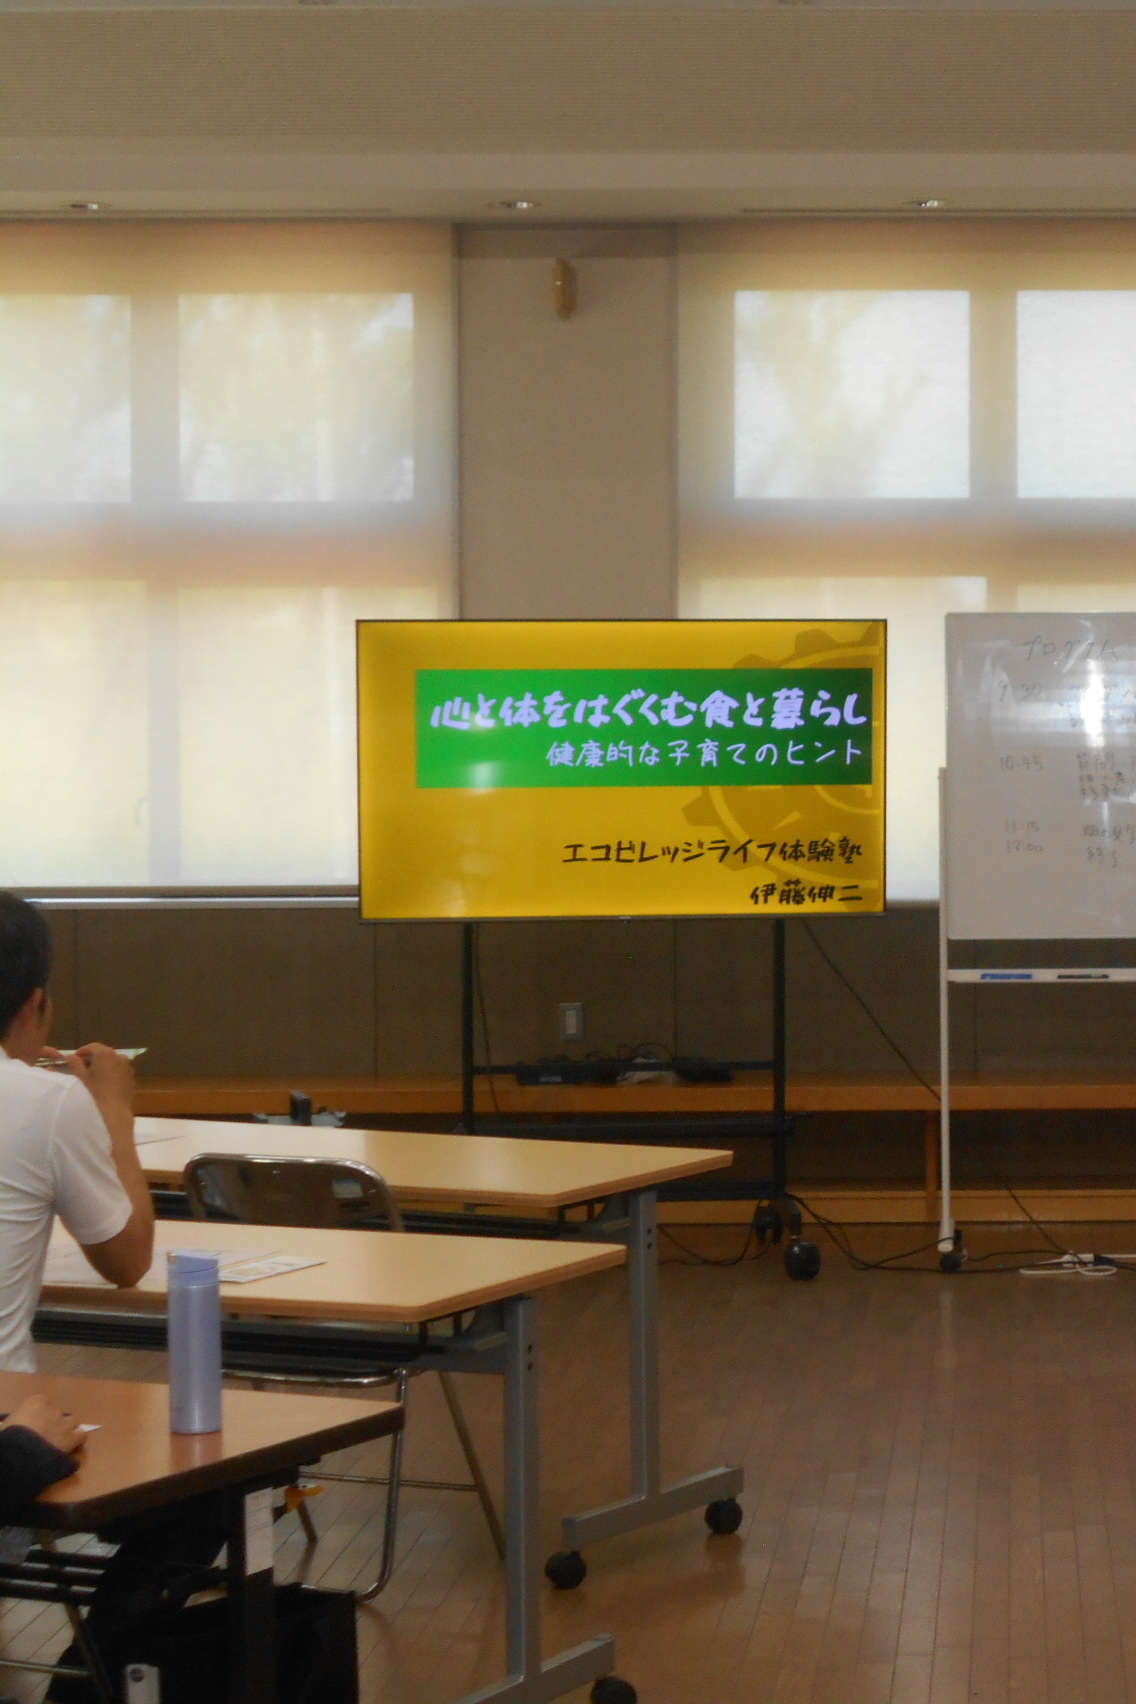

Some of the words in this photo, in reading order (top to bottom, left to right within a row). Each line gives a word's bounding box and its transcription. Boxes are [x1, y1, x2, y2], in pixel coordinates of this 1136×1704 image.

[430, 688, 867, 730] 心と体をはぐくむ食と暮らし
[546, 738, 862, 768] 健康的な子育てのヒント
[562, 836, 863, 864] エコビレッジライフ体験塾
[750, 879, 863, 905] 伊藤伸二
